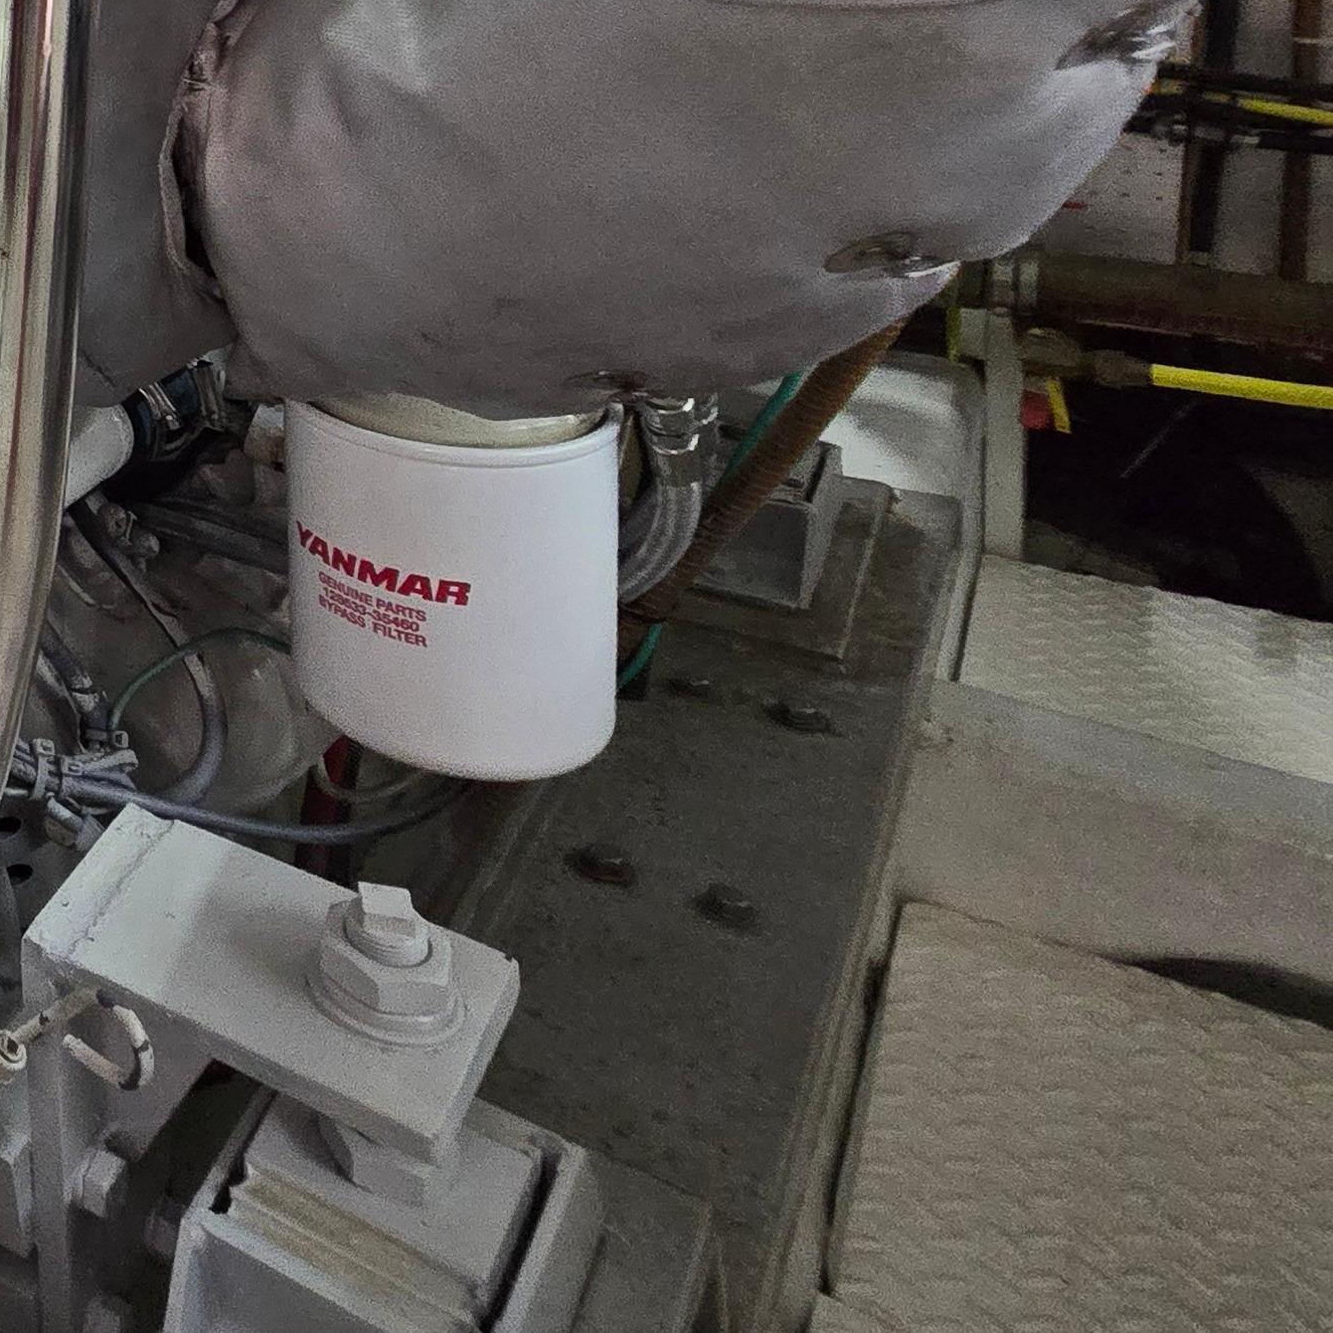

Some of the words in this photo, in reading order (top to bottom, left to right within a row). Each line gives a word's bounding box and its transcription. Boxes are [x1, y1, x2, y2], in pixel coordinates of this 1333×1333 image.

[296, 519, 472, 607] YANMAR
[318, 570, 374, 607] GENUINE
[375, 597, 428, 623] PARTS
[318, 593, 367, 628] BYPASS
[371, 620, 429, 648] FILTER
